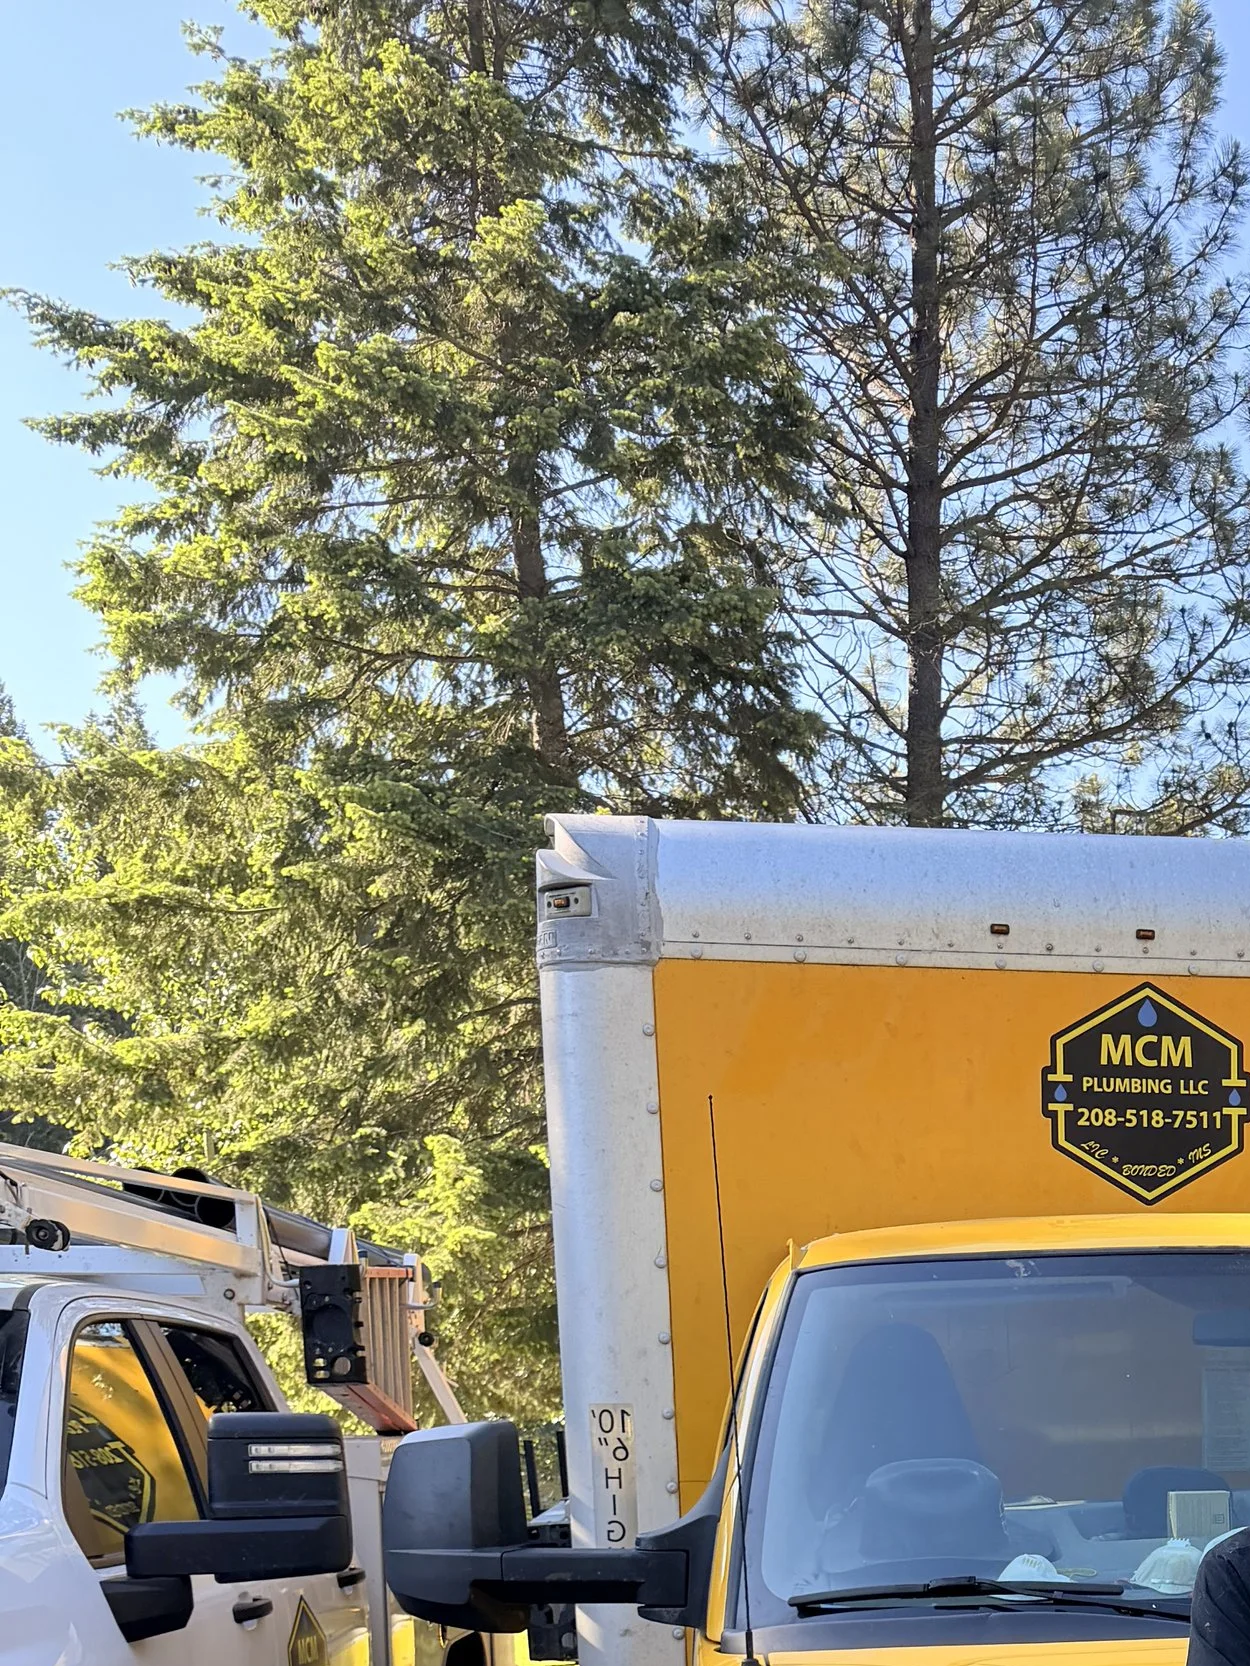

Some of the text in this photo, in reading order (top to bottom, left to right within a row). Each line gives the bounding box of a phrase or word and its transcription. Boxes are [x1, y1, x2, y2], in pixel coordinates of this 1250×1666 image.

[1100, 1033, 1193, 1068] MCM
[1082, 1076, 1209, 1095] PLUMBING LLC
[1077, 1108, 1222, 1129] 208-518-7511
[1080, 1141, 1109, 1159] LIC
[1122, 1164, 1176, 1177] BONDED
